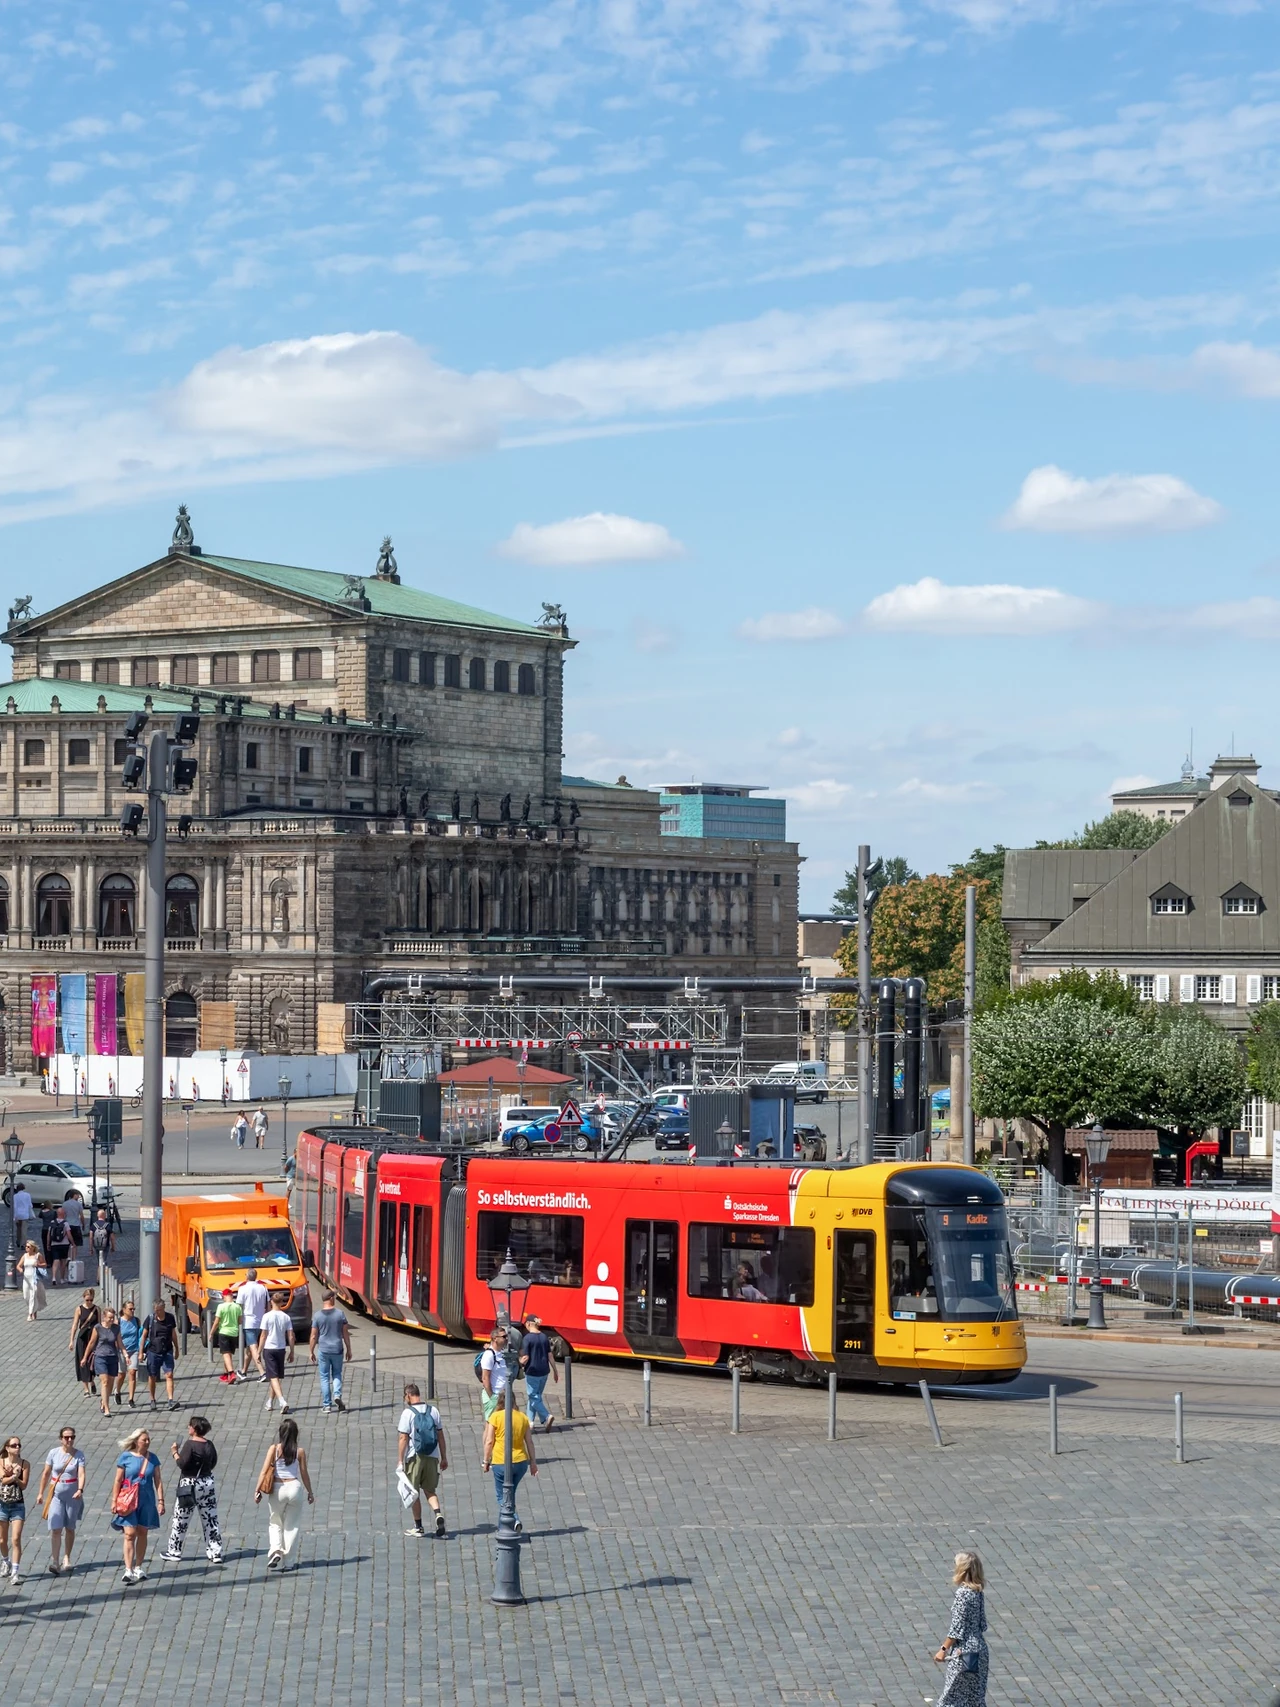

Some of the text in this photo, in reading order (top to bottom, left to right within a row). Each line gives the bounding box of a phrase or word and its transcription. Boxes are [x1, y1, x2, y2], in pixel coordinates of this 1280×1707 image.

[379, 1180, 384, 1194] So
[478, 1190, 591, 1209] So selbstverständlich.
[733, 1202, 768, 1211] Ostsächsische
[733, 1212, 780, 1222] Sparkasse Dresden
[859, 1208, 873, 1216] DVB
[943, 1214, 988, 1226] 9 Kaditz
[843, 1339, 861, 1349] 2911
